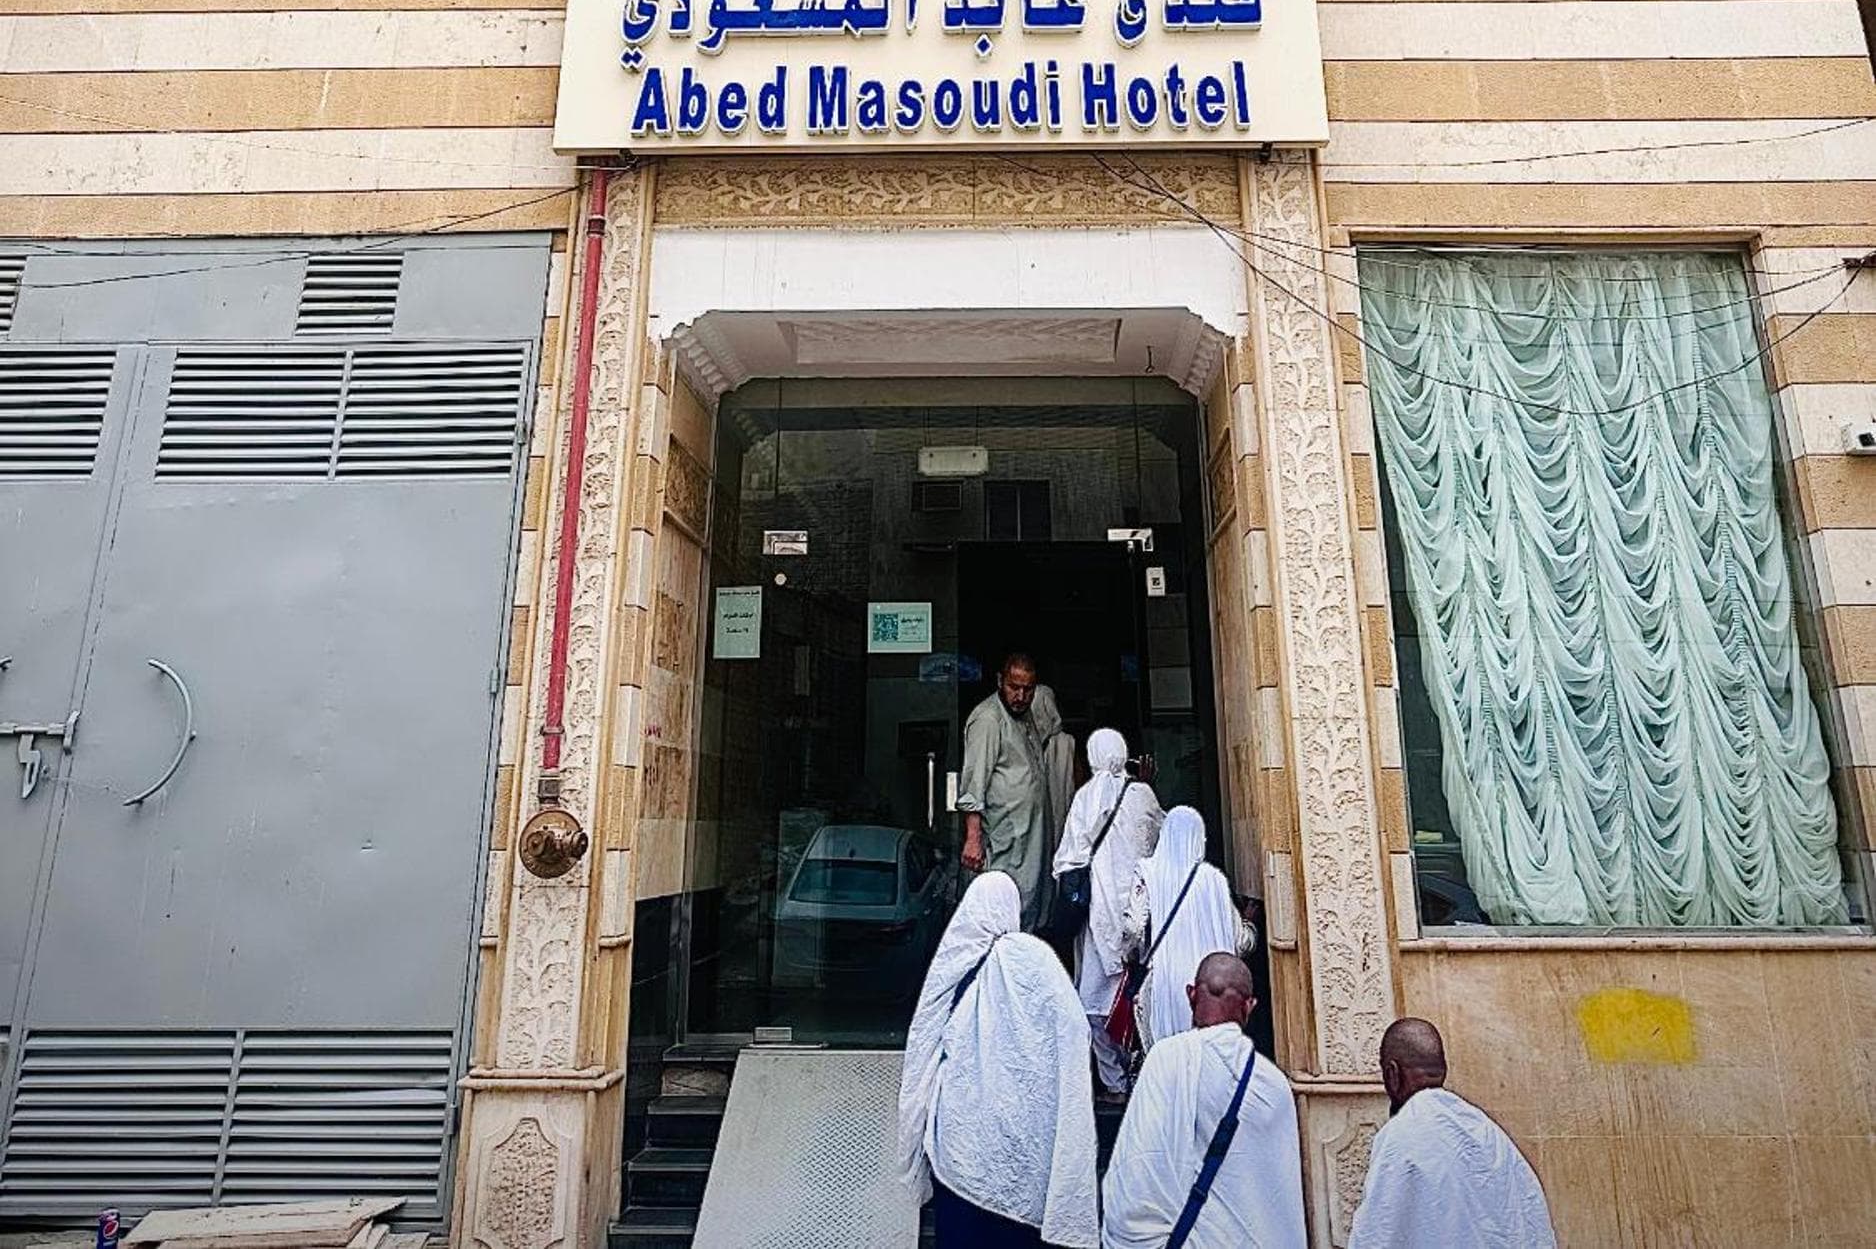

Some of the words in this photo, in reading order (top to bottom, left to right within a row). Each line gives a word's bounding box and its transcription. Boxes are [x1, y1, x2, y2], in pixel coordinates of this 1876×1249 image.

[630, 65, 788, 133] Abed
[807, 60, 1063, 131] Masoudi
[1081, 60, 1252, 128] Hotel
